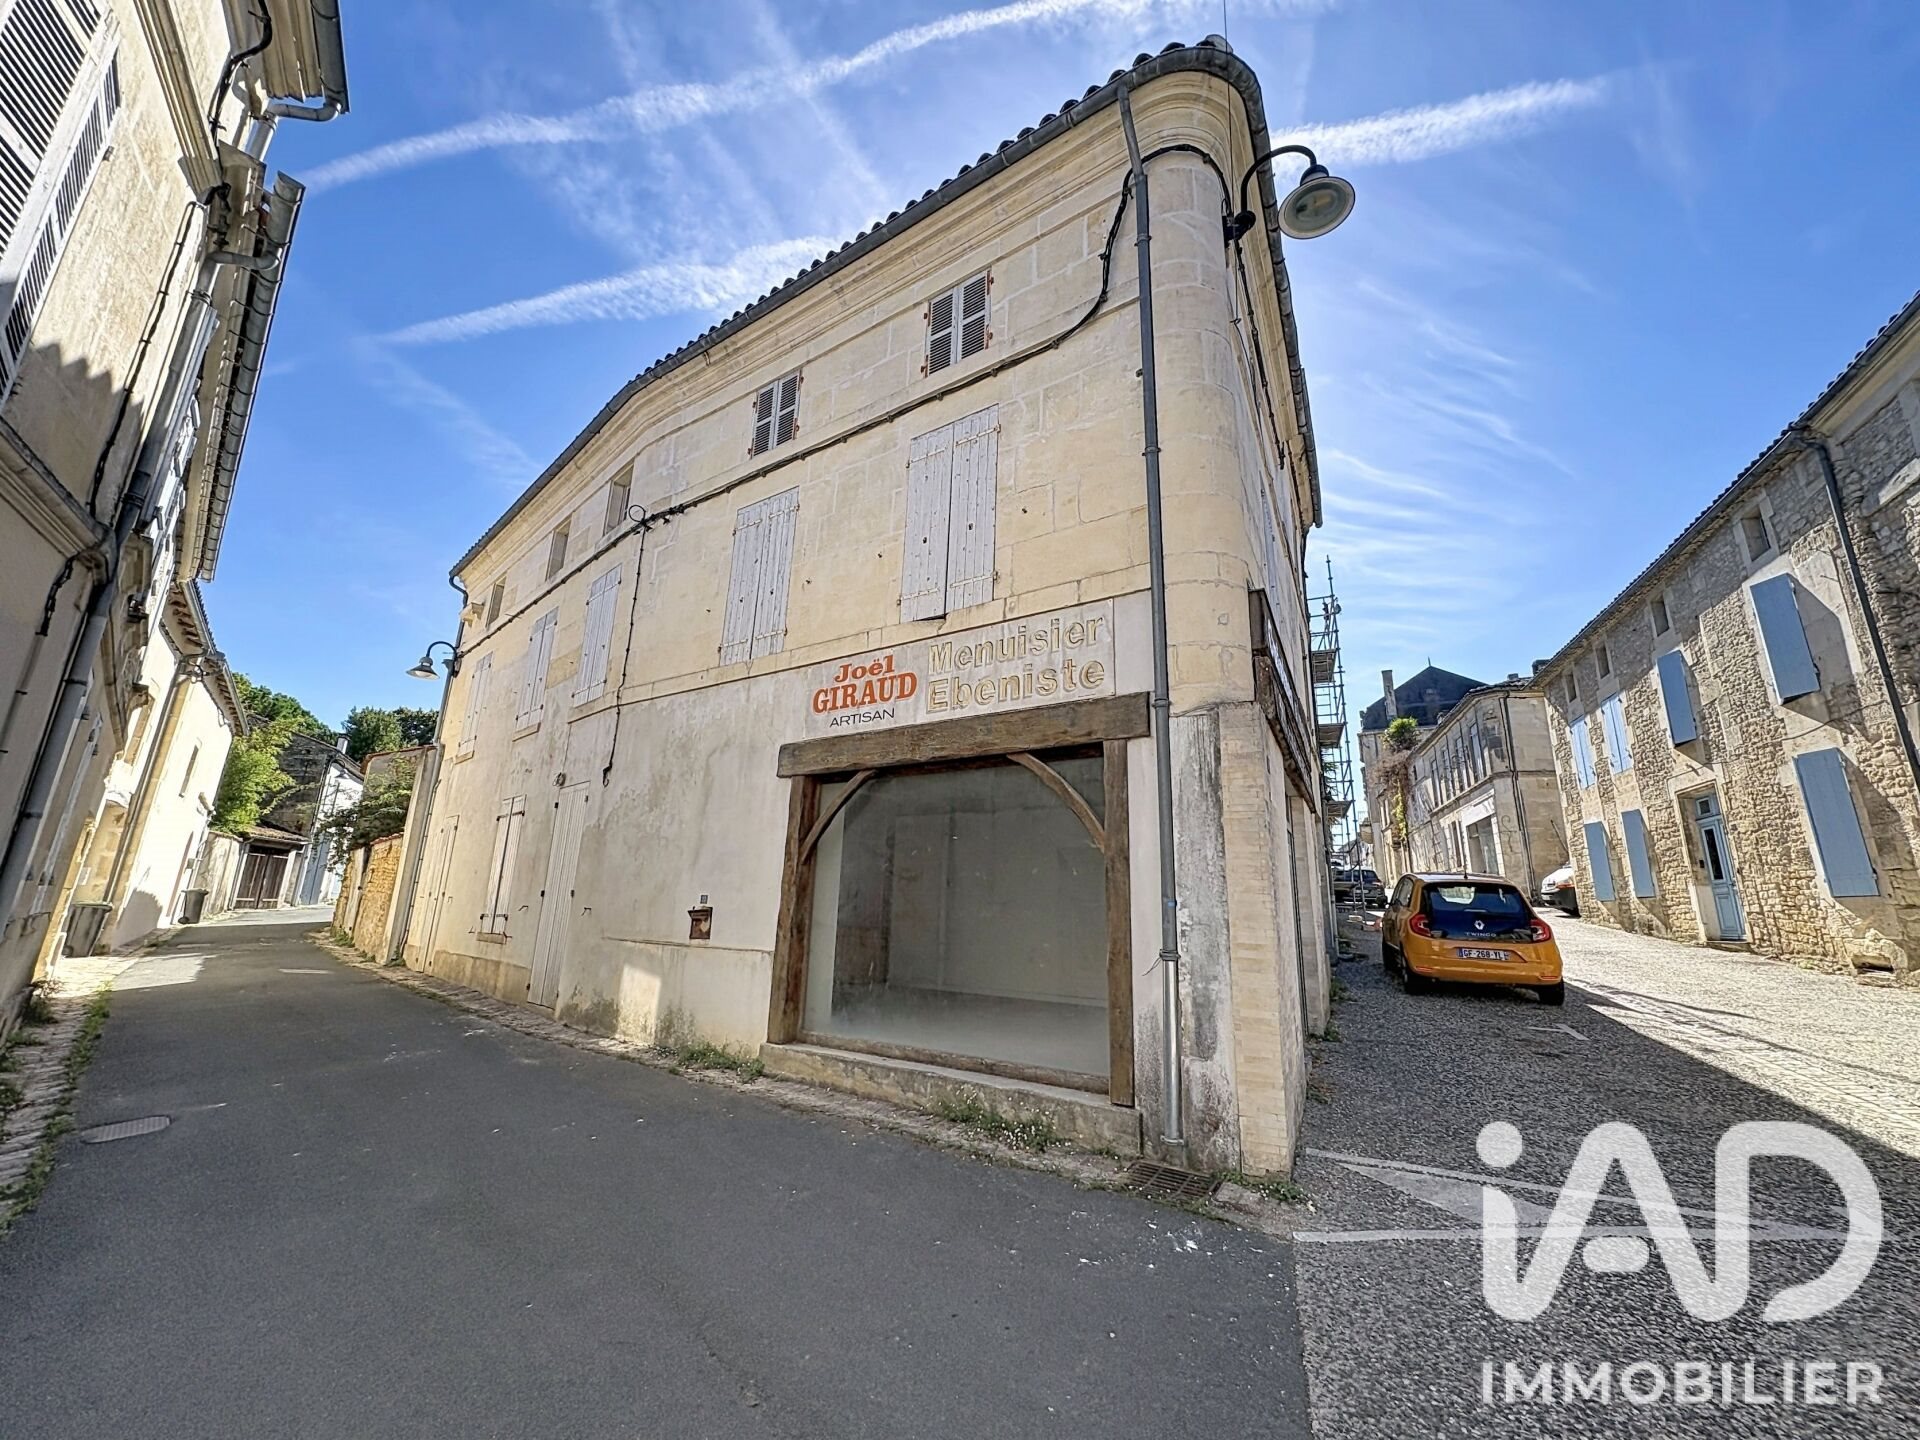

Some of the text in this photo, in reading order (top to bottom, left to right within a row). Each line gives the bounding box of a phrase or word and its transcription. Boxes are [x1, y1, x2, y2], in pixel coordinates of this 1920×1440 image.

[928, 617, 1103, 675] Menuisier
[834, 654, 895, 683] Joël
[926, 658, 1106, 714] Ebeniste
[813, 672, 918, 714] GIRAUD
[829, 707, 895, 728] ARTISAN
